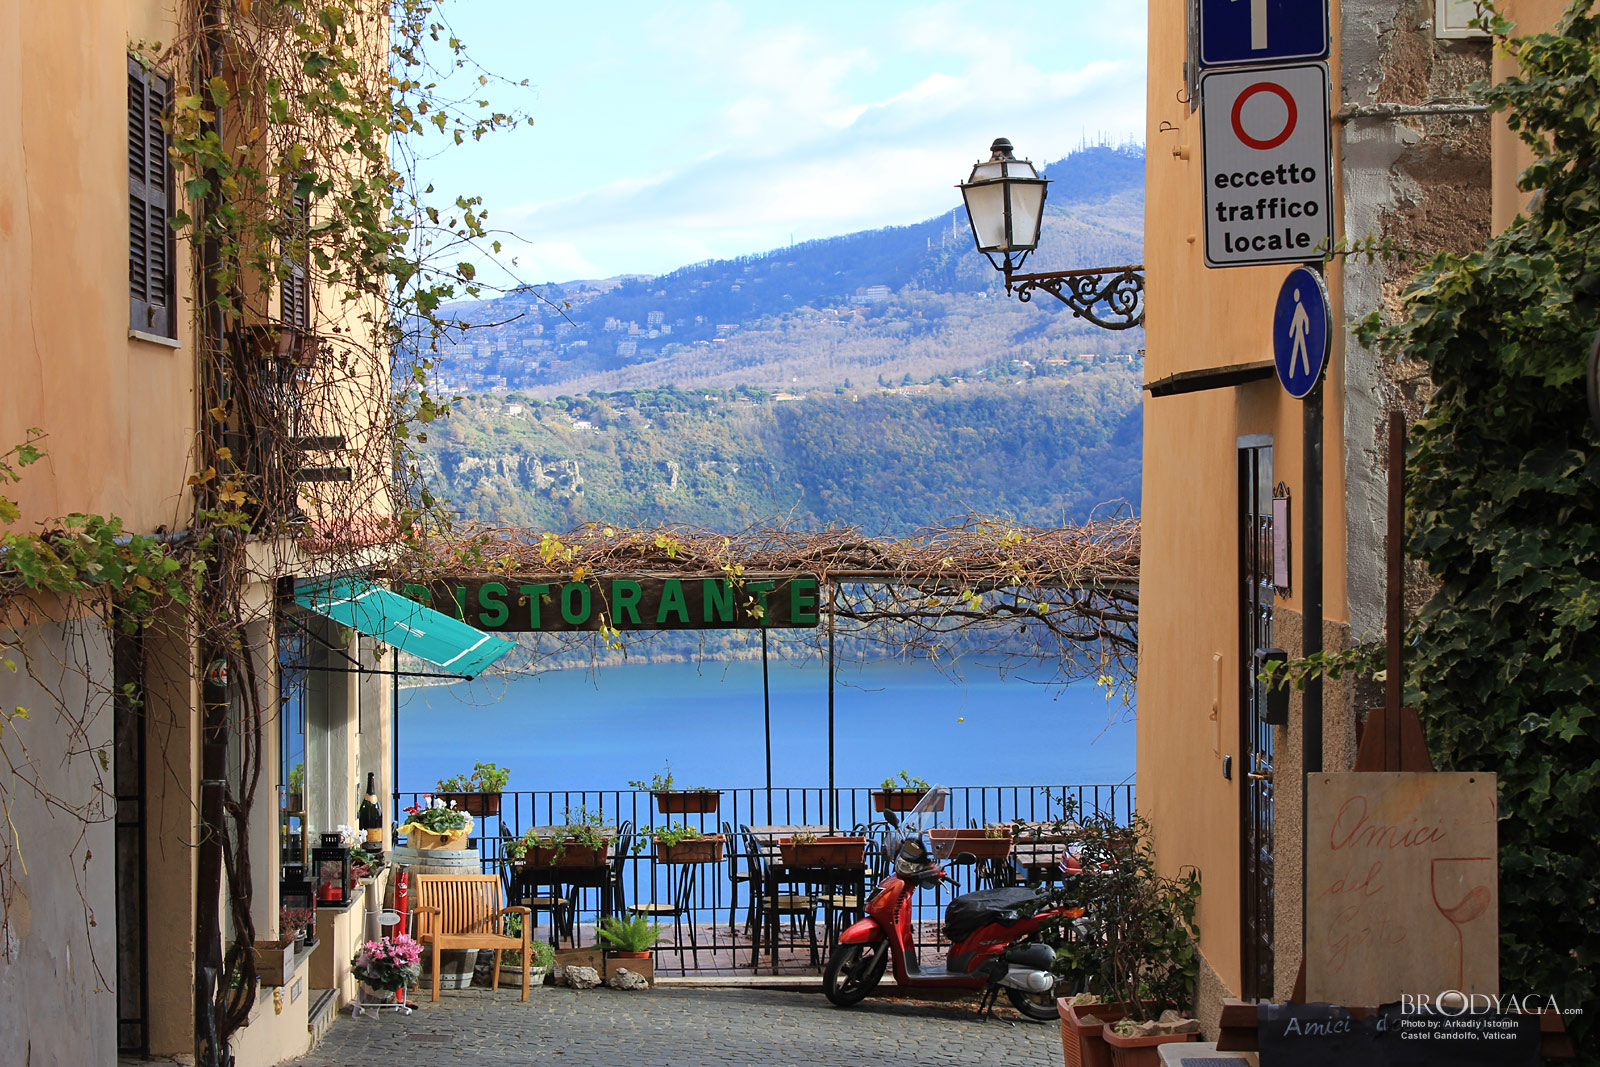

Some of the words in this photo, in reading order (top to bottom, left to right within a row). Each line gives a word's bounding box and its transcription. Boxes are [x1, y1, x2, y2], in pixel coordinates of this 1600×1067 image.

[1214, 163, 1316, 189] eccetto
[1215, 197, 1319, 222] traffico
[1224, 227, 1311, 254] locale
[1283, 1015, 1351, 1037] Amici
